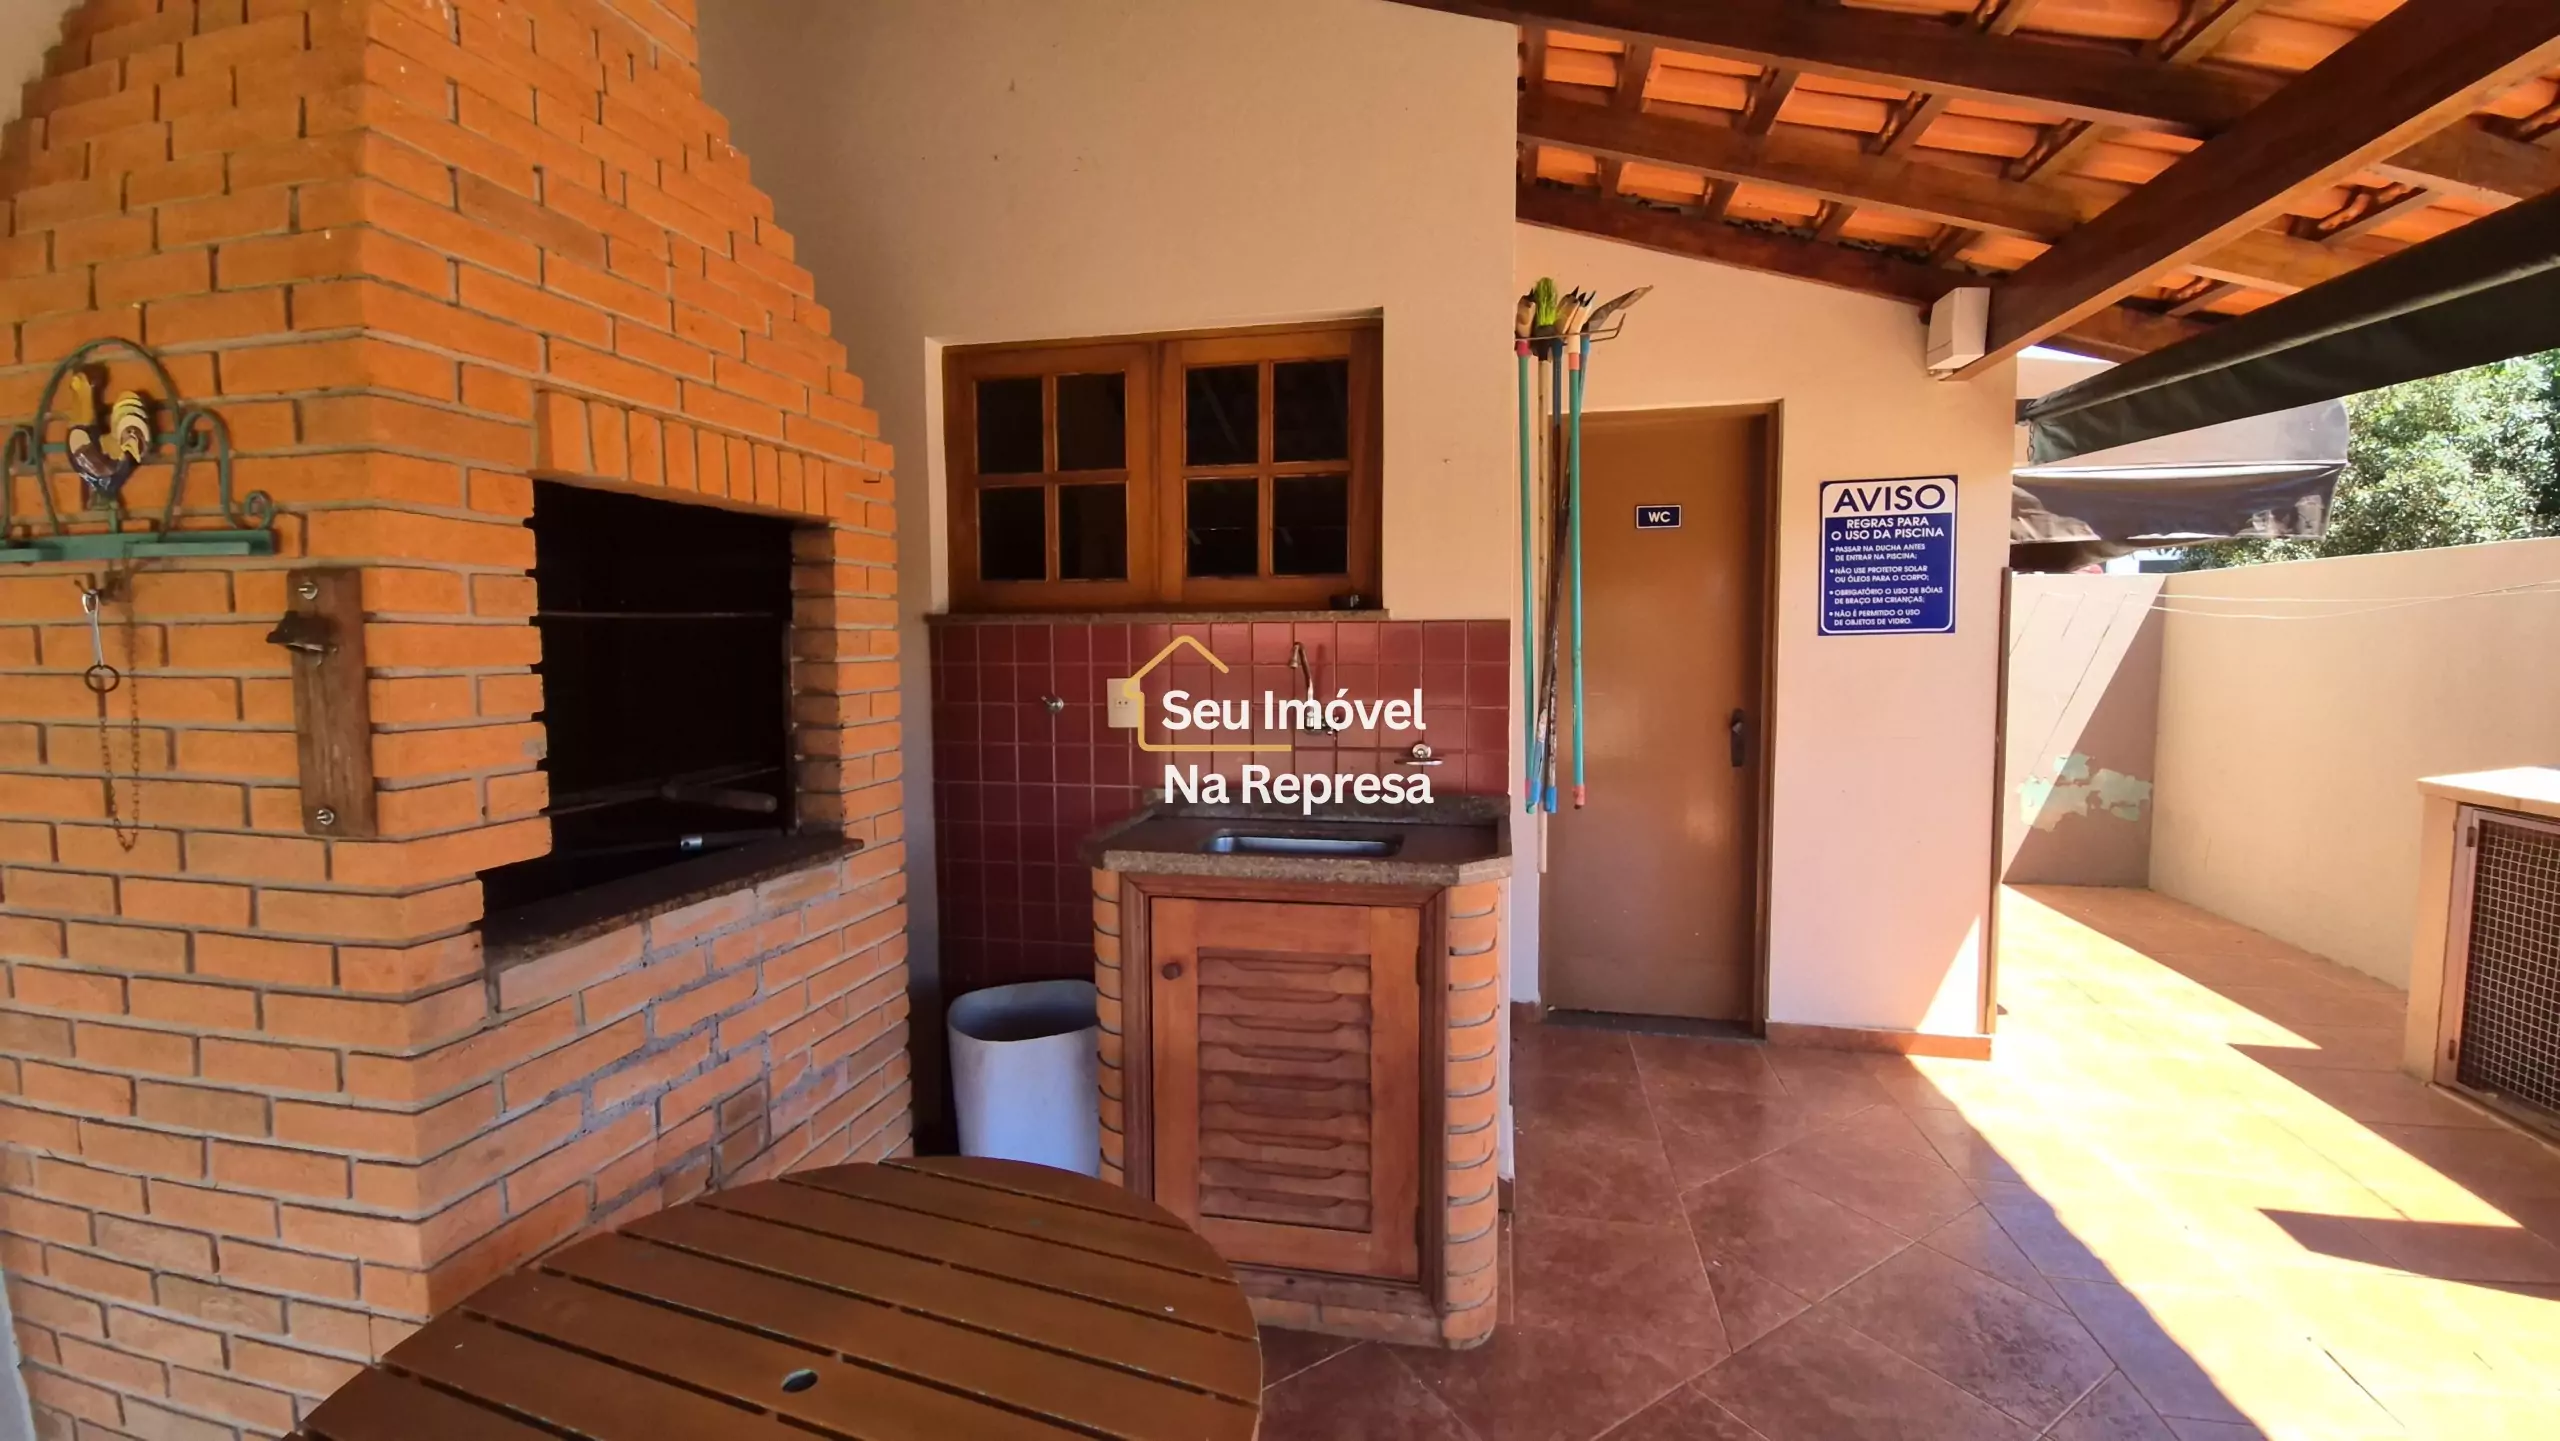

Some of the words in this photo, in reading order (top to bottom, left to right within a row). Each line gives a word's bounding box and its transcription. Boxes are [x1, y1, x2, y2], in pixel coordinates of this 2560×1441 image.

[1833, 484, 1946, 513] AVISO
[1648, 511, 1670, 523] WC
[1846, 518, 1894, 529] REGRAS
[1897, 516, 1929, 526] PARA
[1831, 531, 1842, 540] O
[1846, 530, 1869, 540] USO
[1873, 529, 1893, 539] DA
[1895, 528, 1944, 538] PISCINA
[1835, 566, 1852, 574] NÃO
[1835, 587, 1883, 596] OBRIGATÓRIO
[1846, 597, 1870, 605] BRAÇO
